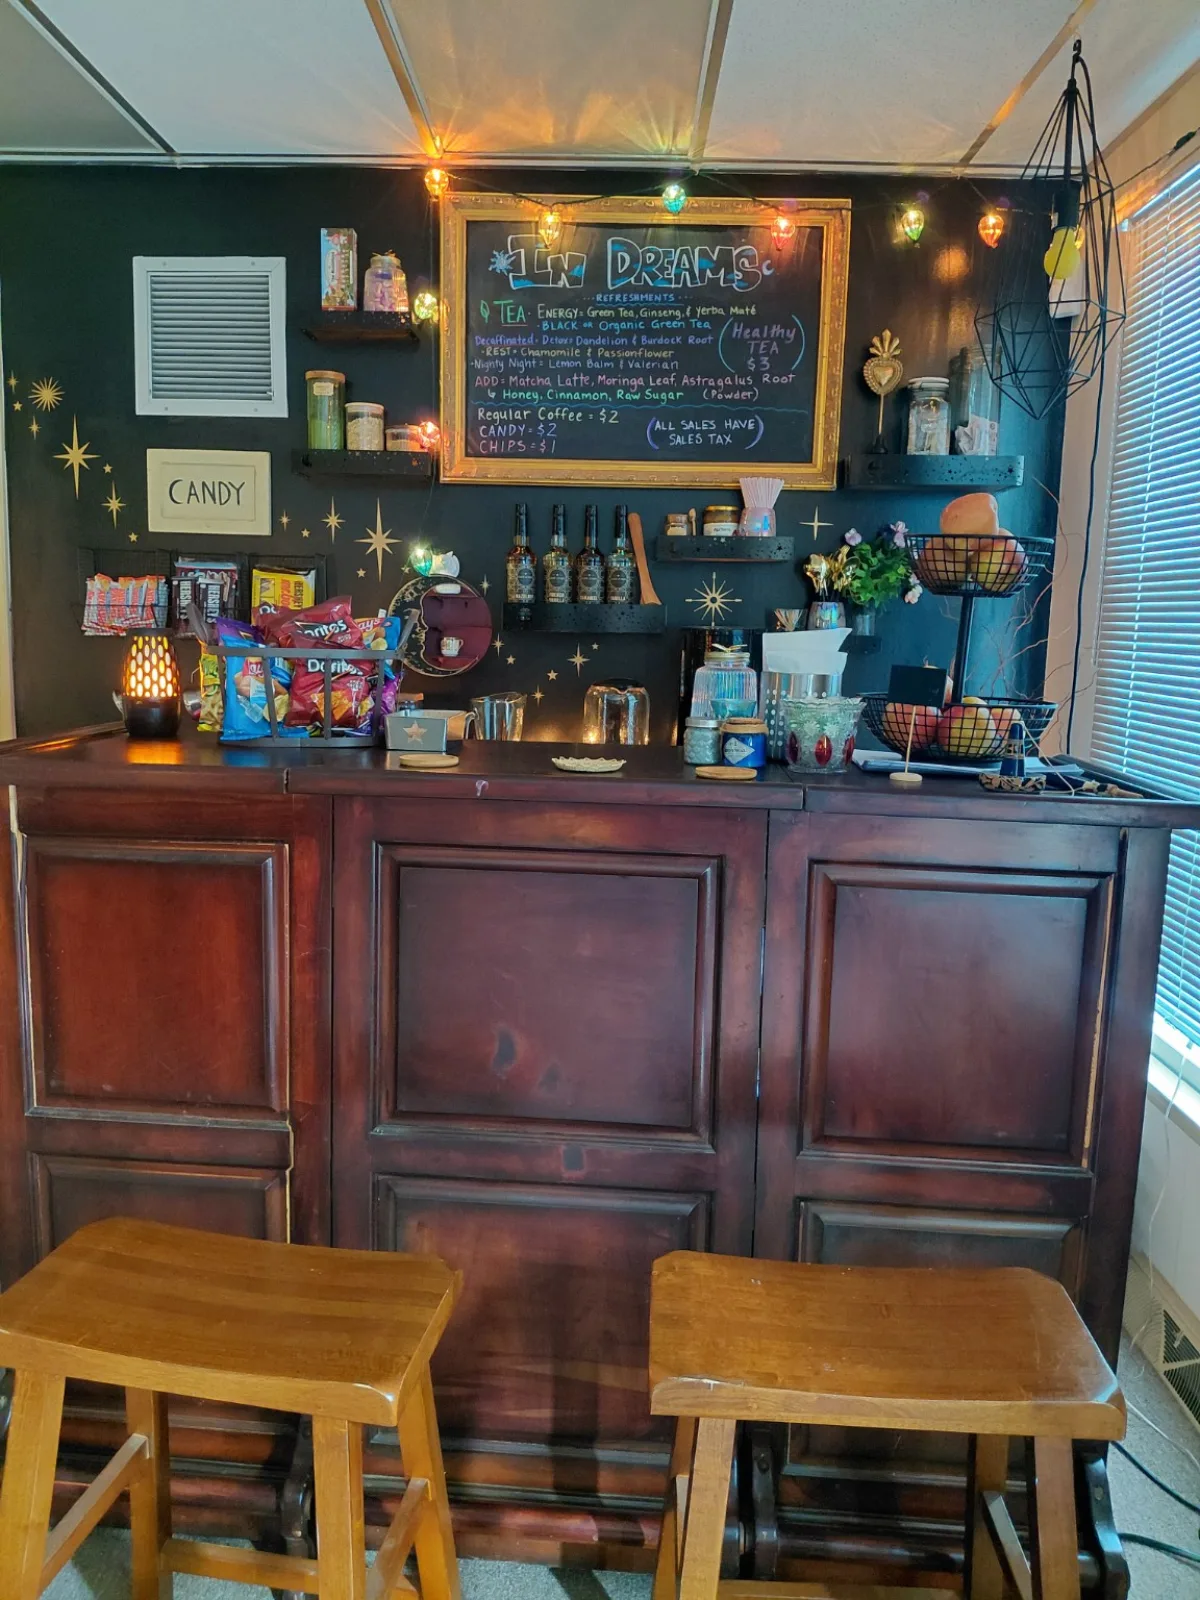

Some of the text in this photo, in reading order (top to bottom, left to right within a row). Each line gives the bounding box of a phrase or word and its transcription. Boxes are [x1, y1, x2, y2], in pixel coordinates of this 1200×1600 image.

[607, 236, 762, 293] DREAMS
[493, 300, 526, 324] TEA
[587, 308, 615, 318] Green
[696, 306, 726, 318] Yerba
[542, 321, 578, 330] BLACK
[598, 321, 645, 335] Organic
[651, 320, 685, 329] Green
[690, 320, 712, 329] Tea
[732, 322, 796, 343] Healthy
[576, 335, 628, 346] Dandelion
[688, 335, 714, 344] Root
[747, 340, 779, 355] TEA
[520, 347, 581, 357] Chamomile
[598, 347, 675, 358] Passionflower
[508, 358, 537, 374] Night
[548, 359, 582, 369] Lemon
[587, 359, 614, 369] Balm
[628, 360, 679, 370] Valerian
[747, 356, 771, 372] $3
[509, 375, 552, 387] Matcha
[597, 375, 645, 392] Moringa
[682, 375, 753, 392] Astragalus
[762, 373, 797, 385] Root
[616, 389, 641, 400] Raw
[644, 388, 684, 405] Sugar
[702, 386, 760, 402] (Powder)
[478, 407, 532, 425] Regular
[537, 406, 583, 422] Coffee
[599, 407, 620, 424] $2
[479, 424, 526, 438] CANDY
[536, 422, 557, 438] $2
[682, 420, 717, 430] SALES
[479, 440, 526, 454] CHIPS
[539, 438, 556, 454] $1
[669, 433, 733, 446] SALES TAX
[168, 478, 246, 507] CANDY
